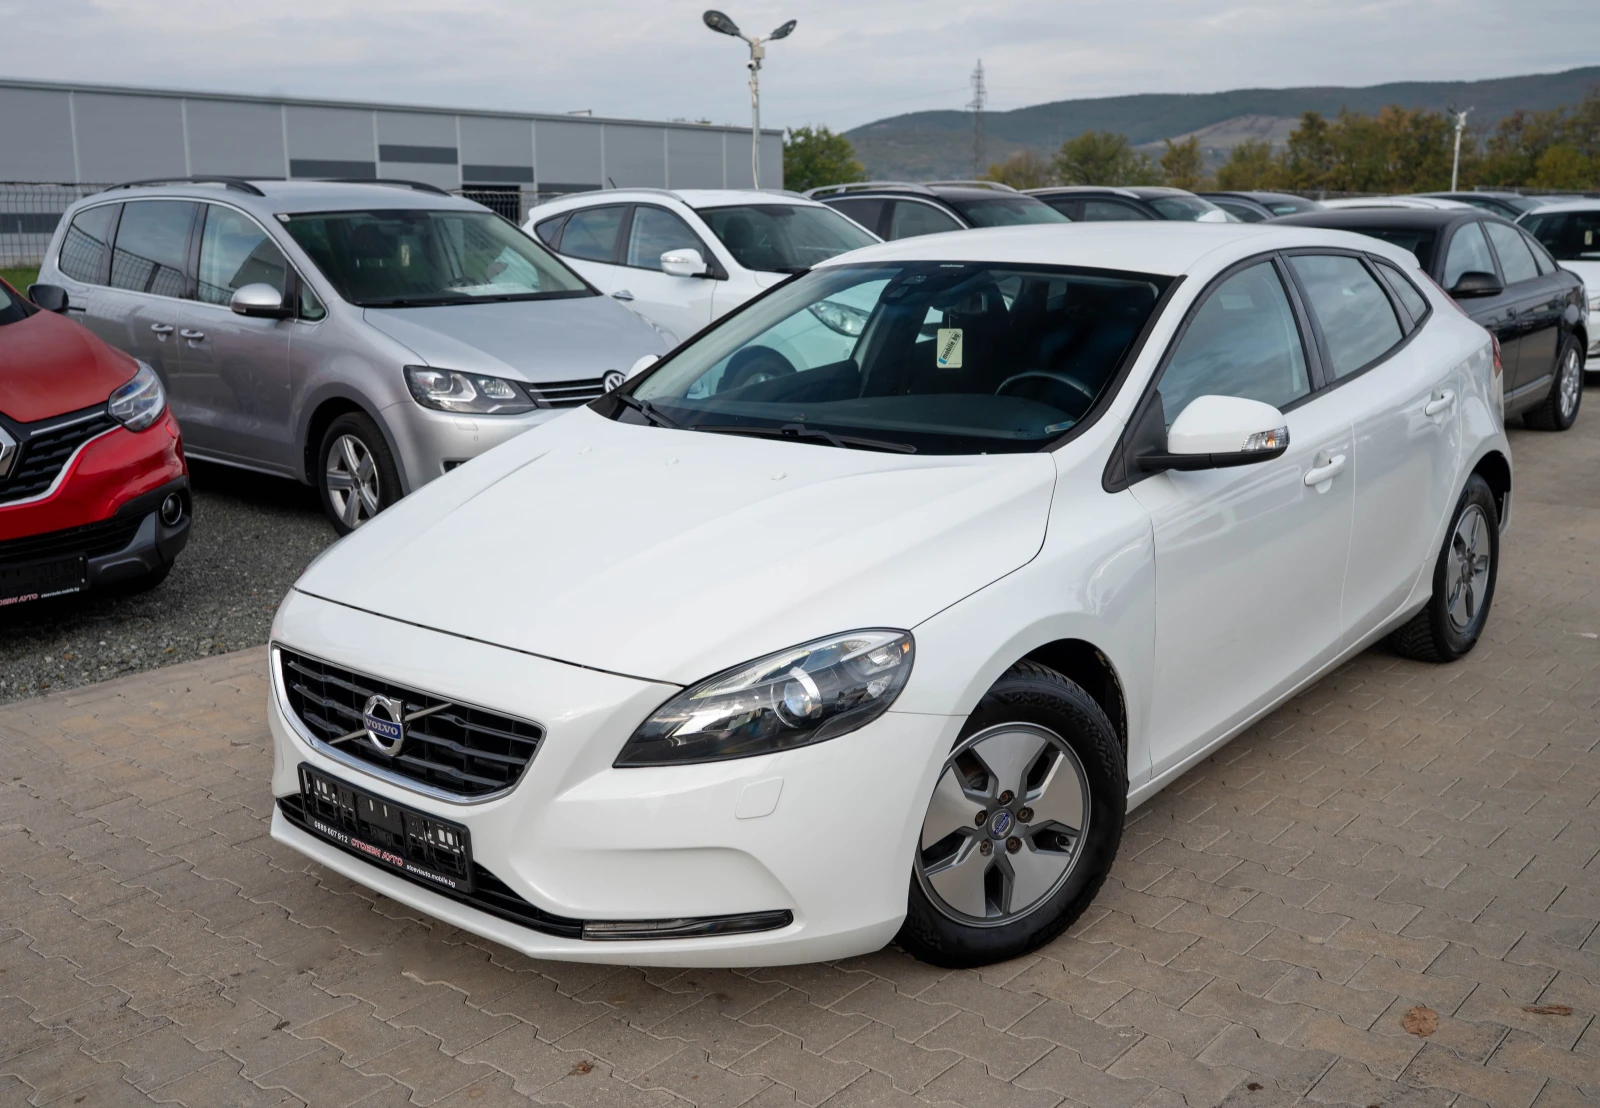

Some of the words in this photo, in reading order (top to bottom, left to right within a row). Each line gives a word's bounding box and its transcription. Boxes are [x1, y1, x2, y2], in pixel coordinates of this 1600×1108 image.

[942, 333, 960, 360] mobile.bg
[364, 717, 399, 736] VOLVO
[337, 832, 348, 844] 912
[406, 864, 456, 888] stoeviauto.mobile.bg
